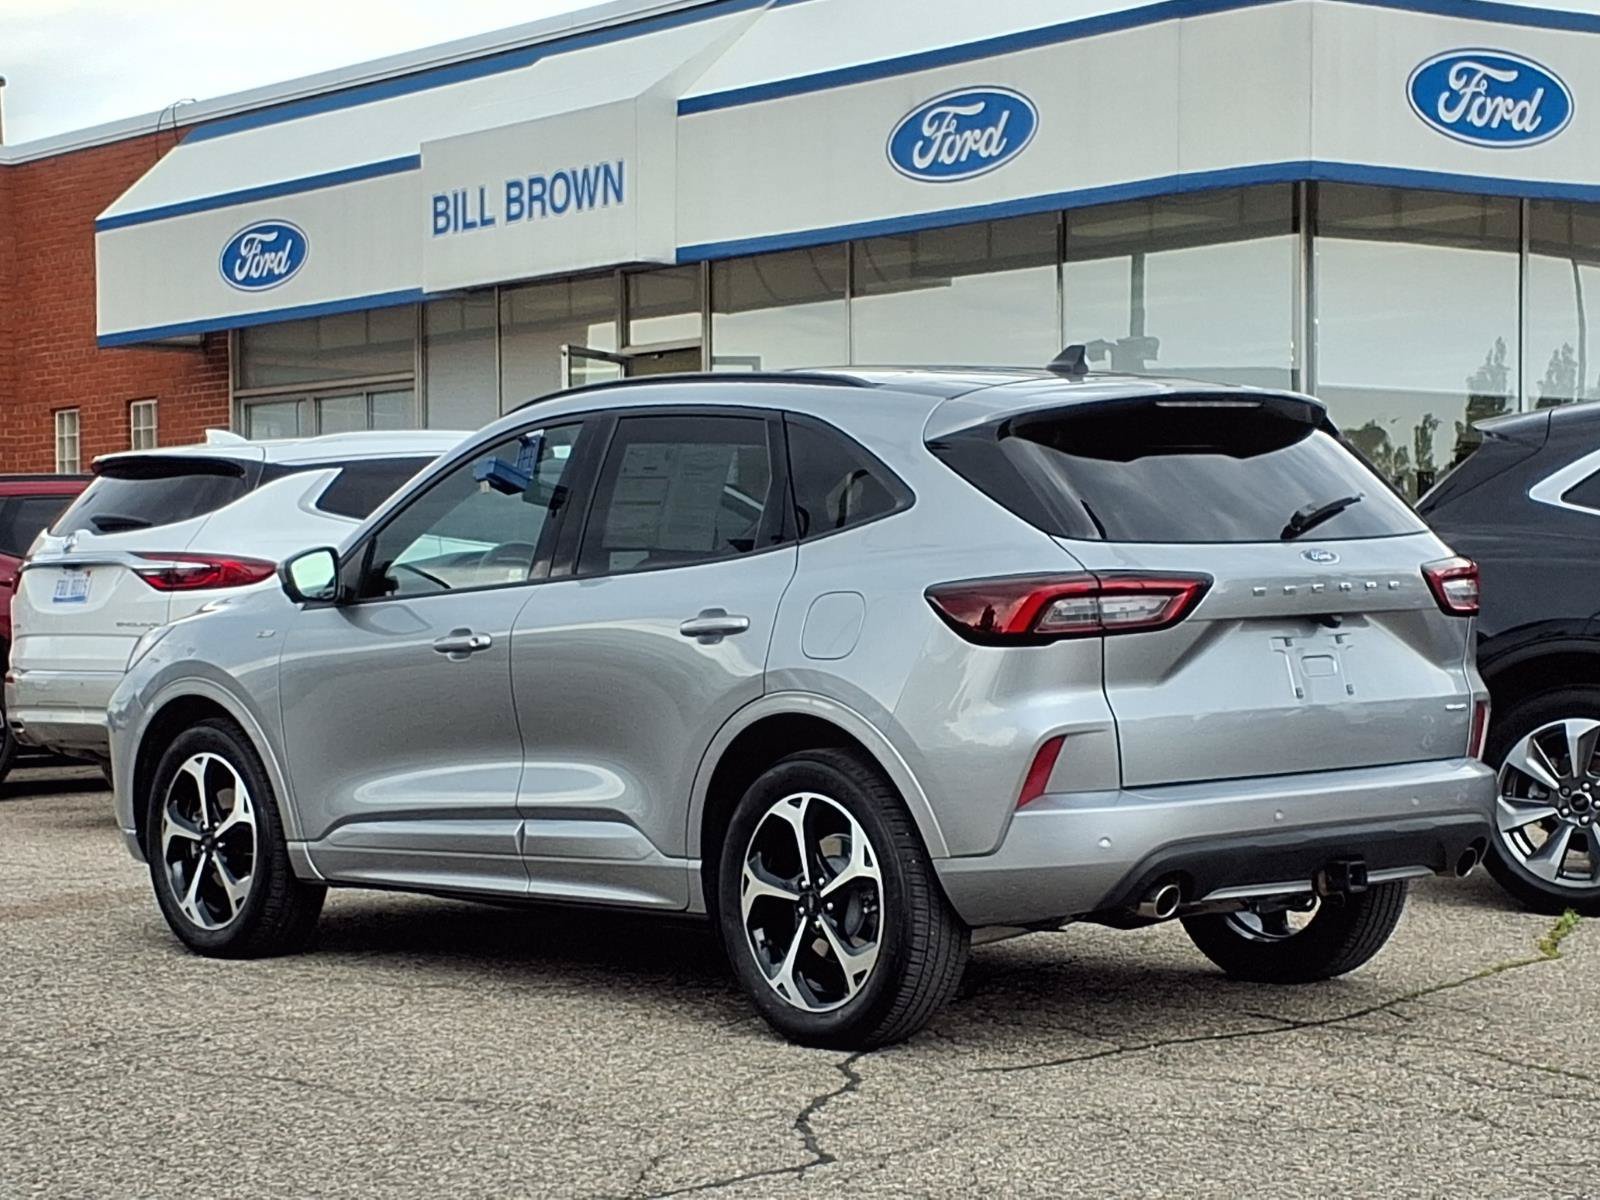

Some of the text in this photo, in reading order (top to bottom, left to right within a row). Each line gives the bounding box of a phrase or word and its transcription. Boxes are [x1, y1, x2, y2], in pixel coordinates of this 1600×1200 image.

[1437, 60, 1545, 133] Ford
[912, 101, 1010, 169] Ford
[432, 160, 625, 236] BILL BROWN
[234, 231, 293, 281] Ford
